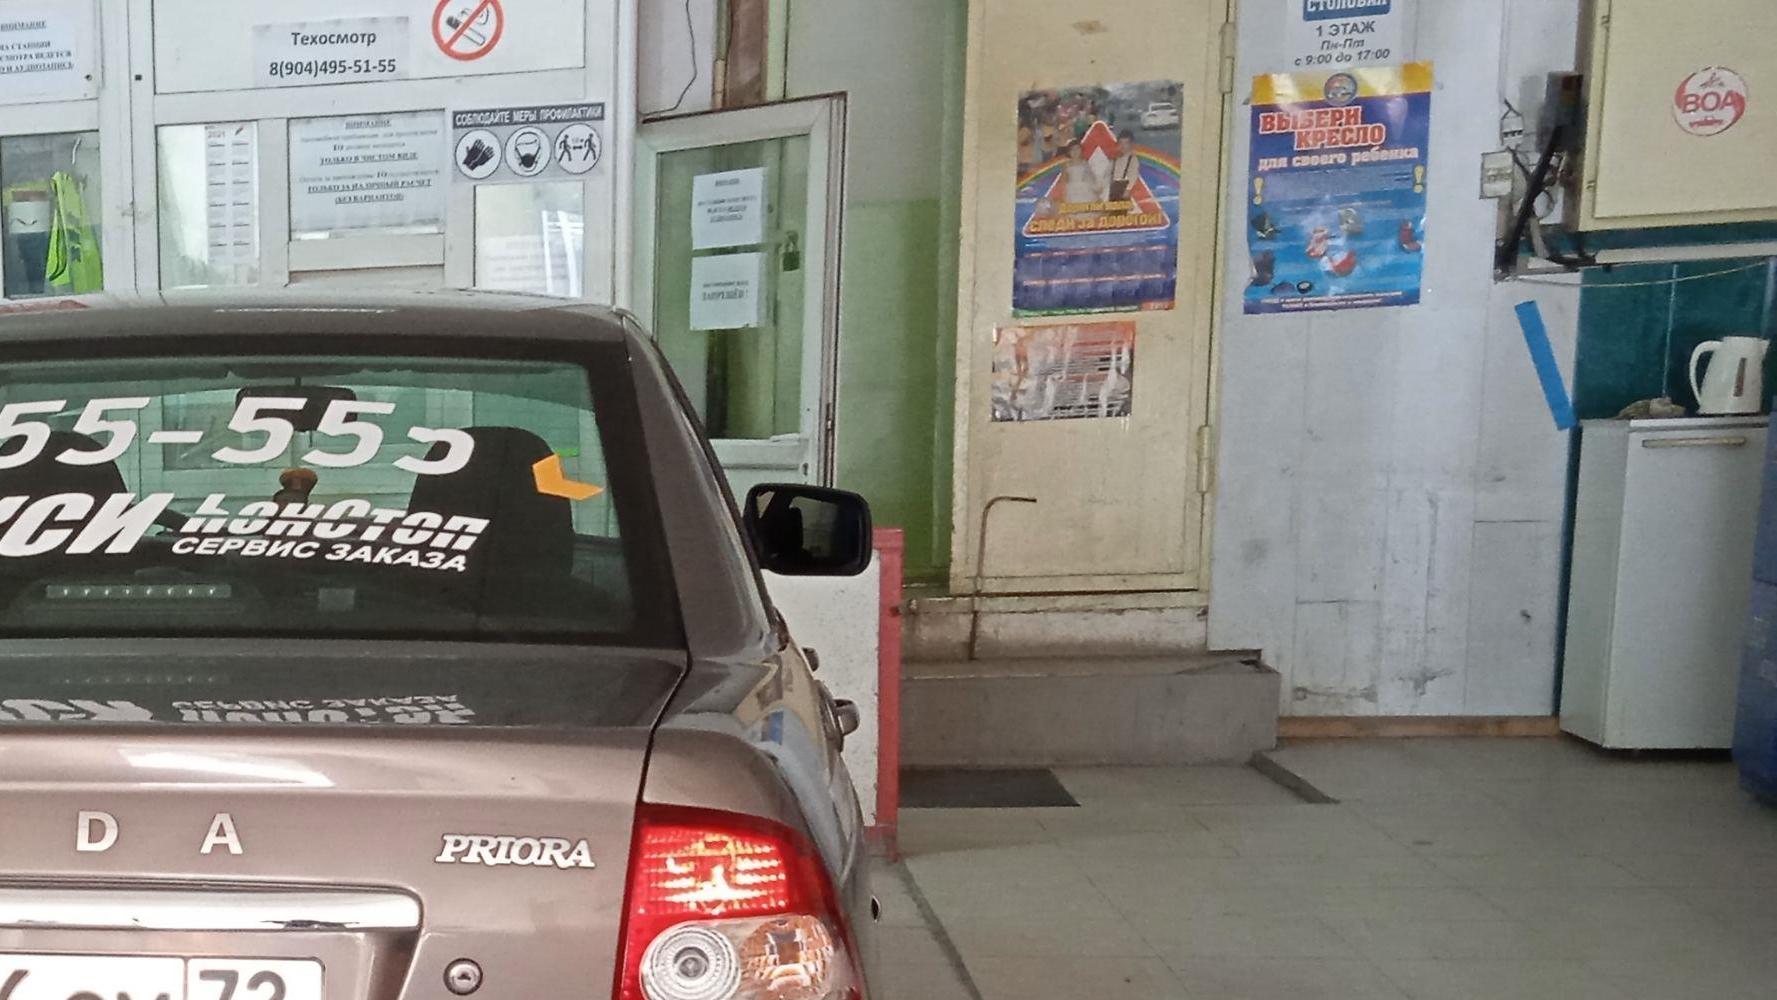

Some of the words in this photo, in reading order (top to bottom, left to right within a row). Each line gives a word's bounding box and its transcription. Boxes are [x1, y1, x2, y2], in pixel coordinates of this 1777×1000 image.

[290, 31, 377, 47] Техосмотр
[1316, 25, 1323, 37] 1
[1328, 20, 1376, 36] ЭТАЖ
[1335, 51, 1353, 63] до
[269, 58, 397, 79] 8(904)495-51-55
[455, 110, 510, 126] СОБЛЮДАЙТЕ
[512, 109, 537, 123] МЕРЫ
[539, 105, 602, 121] ПРОФИЛАКТИКИ
[1260, 106, 1362, 134] ВЫБЕРИ
[1295, 123, 1386, 150] КРЕСЛО
[1258, 156, 1288, 172] для
[1292, 152, 1347, 168] своего
[171, 536, 321, 559] СЕРВИС
[325, 542, 467, 573] ЗАКАЗА
[434, 833, 596, 869] PRIORA
